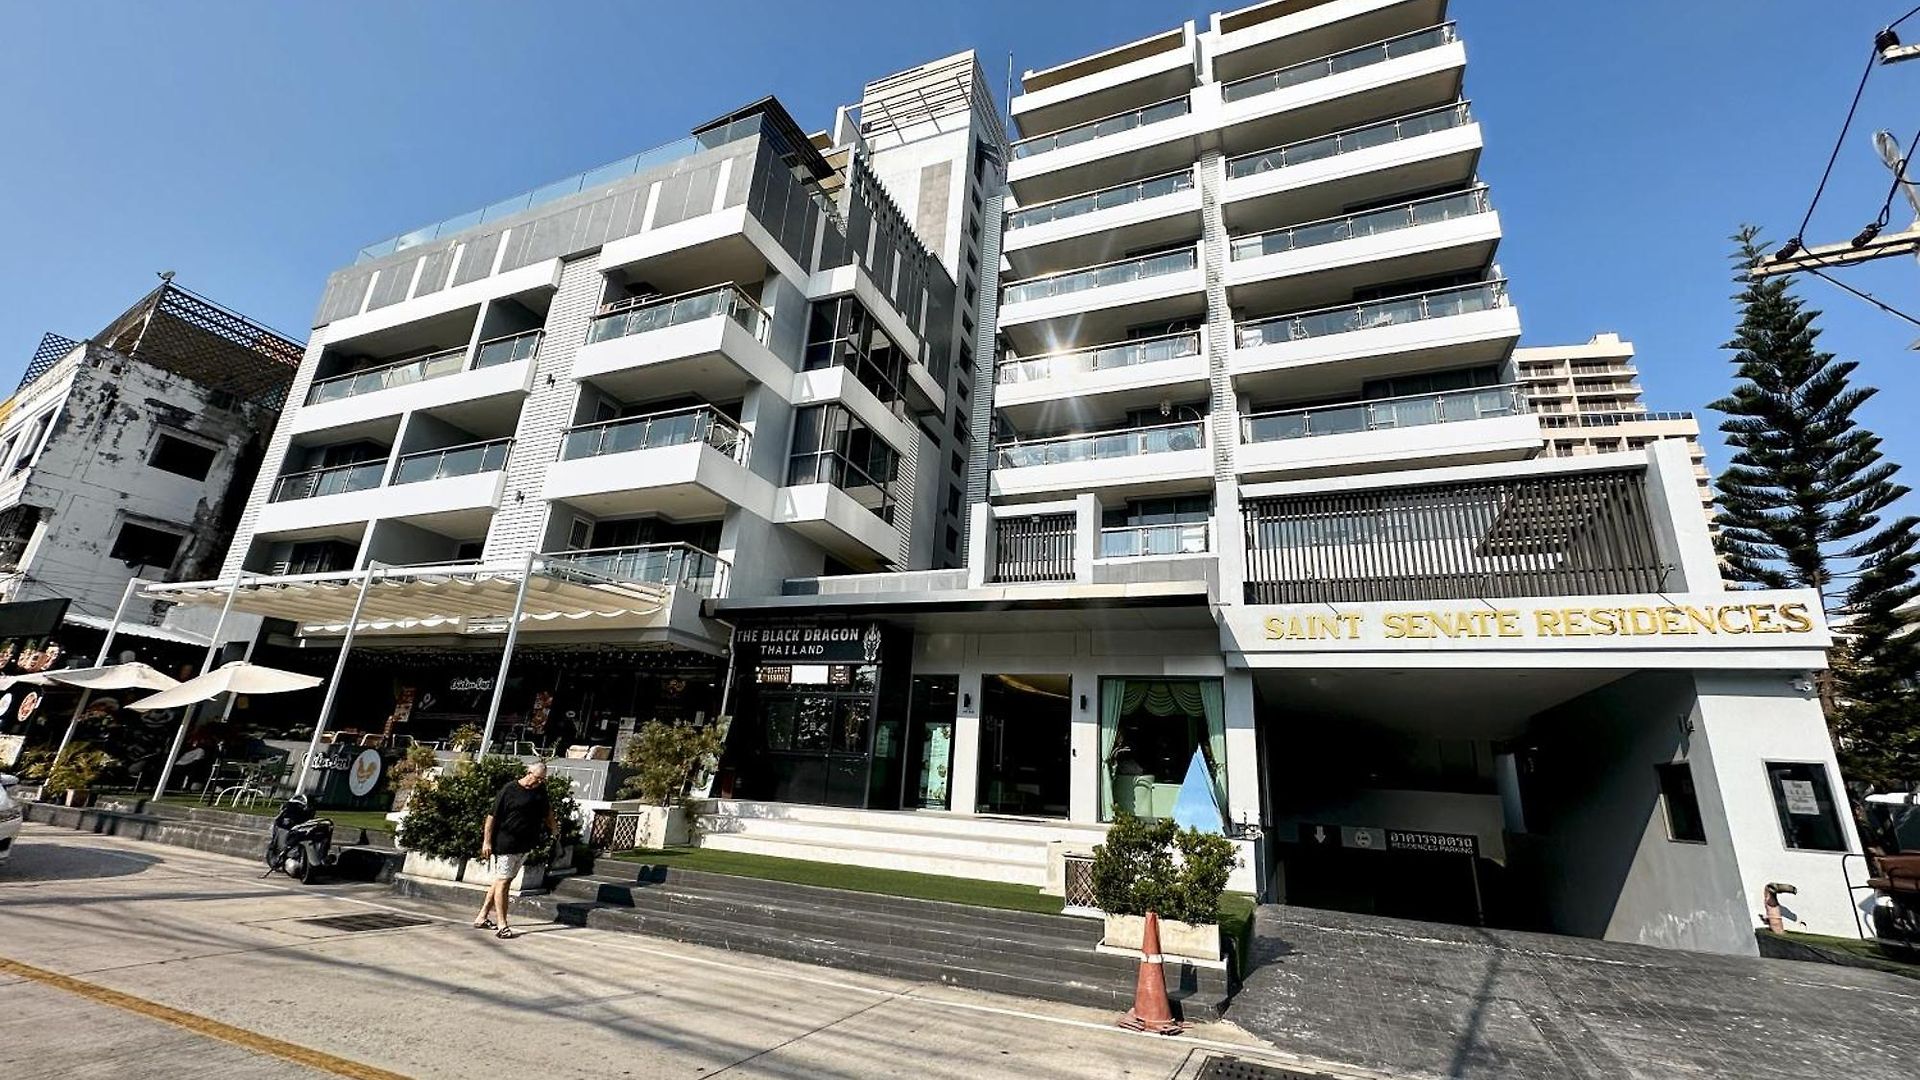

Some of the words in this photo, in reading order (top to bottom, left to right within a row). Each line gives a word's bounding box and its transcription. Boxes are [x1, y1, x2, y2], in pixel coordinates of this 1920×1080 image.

[1264, 611, 1364, 640] SAINT
[1383, 609, 1524, 639] SENATE
[1533, 602, 1814, 637] RESIDENCES
[736, 630, 759, 643] THE
[761, 629, 800, 642] BLACK
[803, 628, 859, 642] DRAGON
[760, 645, 824, 655] THAILAND
[1391, 842, 1438, 852] RESIDENCES
